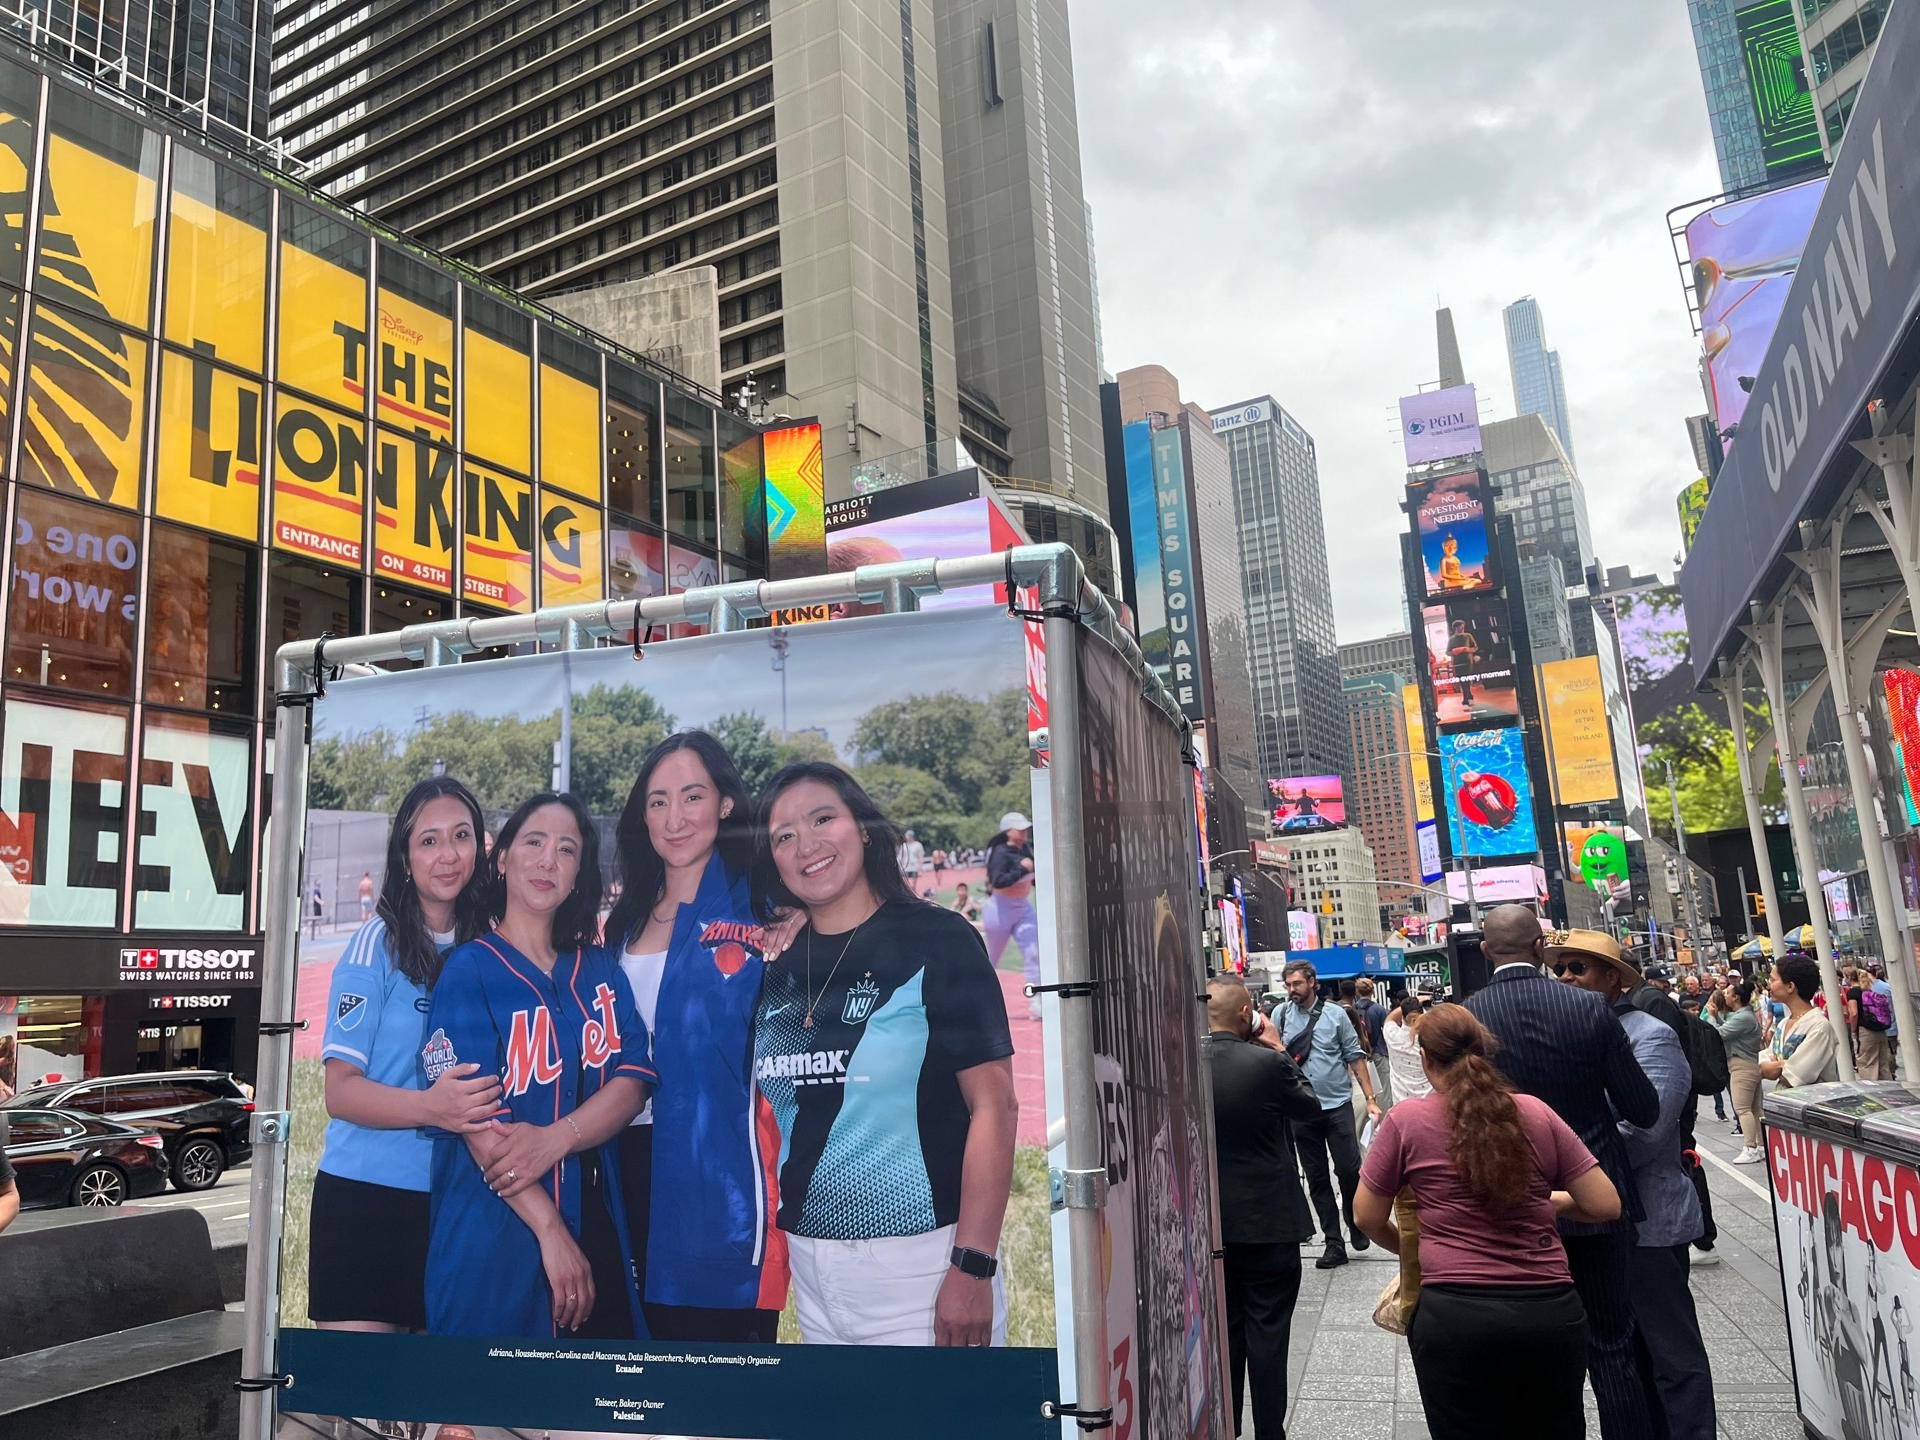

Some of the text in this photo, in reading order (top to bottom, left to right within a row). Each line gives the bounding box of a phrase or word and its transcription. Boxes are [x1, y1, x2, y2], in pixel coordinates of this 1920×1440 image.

[1761, 118, 1897, 493] OLD NAVY
[333, 320, 452, 417] THE
[1211, 414, 1242, 431] lianz
[1429, 412, 1465, 430] PGIM
[189, 338, 581, 569] LION KING
[824, 496, 874, 516] ARRIOTT
[1422, 499, 1478, 517] INVESTMENT
[1441, 494, 1456, 504] NO
[824, 508, 868, 527] ARQUIS
[1433, 511, 1469, 525] NEEDED
[281, 526, 505, 600] ENTRANCE ON 45TH STREET
[1158, 444, 1194, 706] TIMES SQUARE
[776, 605, 825, 626] KING
[1433, 668, 1512, 687] upscale every moment
[159, 949, 256, 969] TISSOT
[119, 970, 255, 982] SWISS WATCHES SINCE 1853
[173, 995, 232, 1009] TISSOT
[341, 993, 358, 1006] MLS
[847, 997, 872, 1019] NY
[423, 1048, 454, 1066] WORLD
[1768, 1126, 1920, 1271] CHICAGO
[488, 1348, 781, 1367] Adriana, Housekeeper; Carolina and Macarena, Data Researchers; Mayra, Community Organizer
[615, 1363, 644, 1375] Ecuador
[594, 1397, 665, 1410] Taiseer, Bakery Owner
[613, 1410, 645, 1421] Palestine
